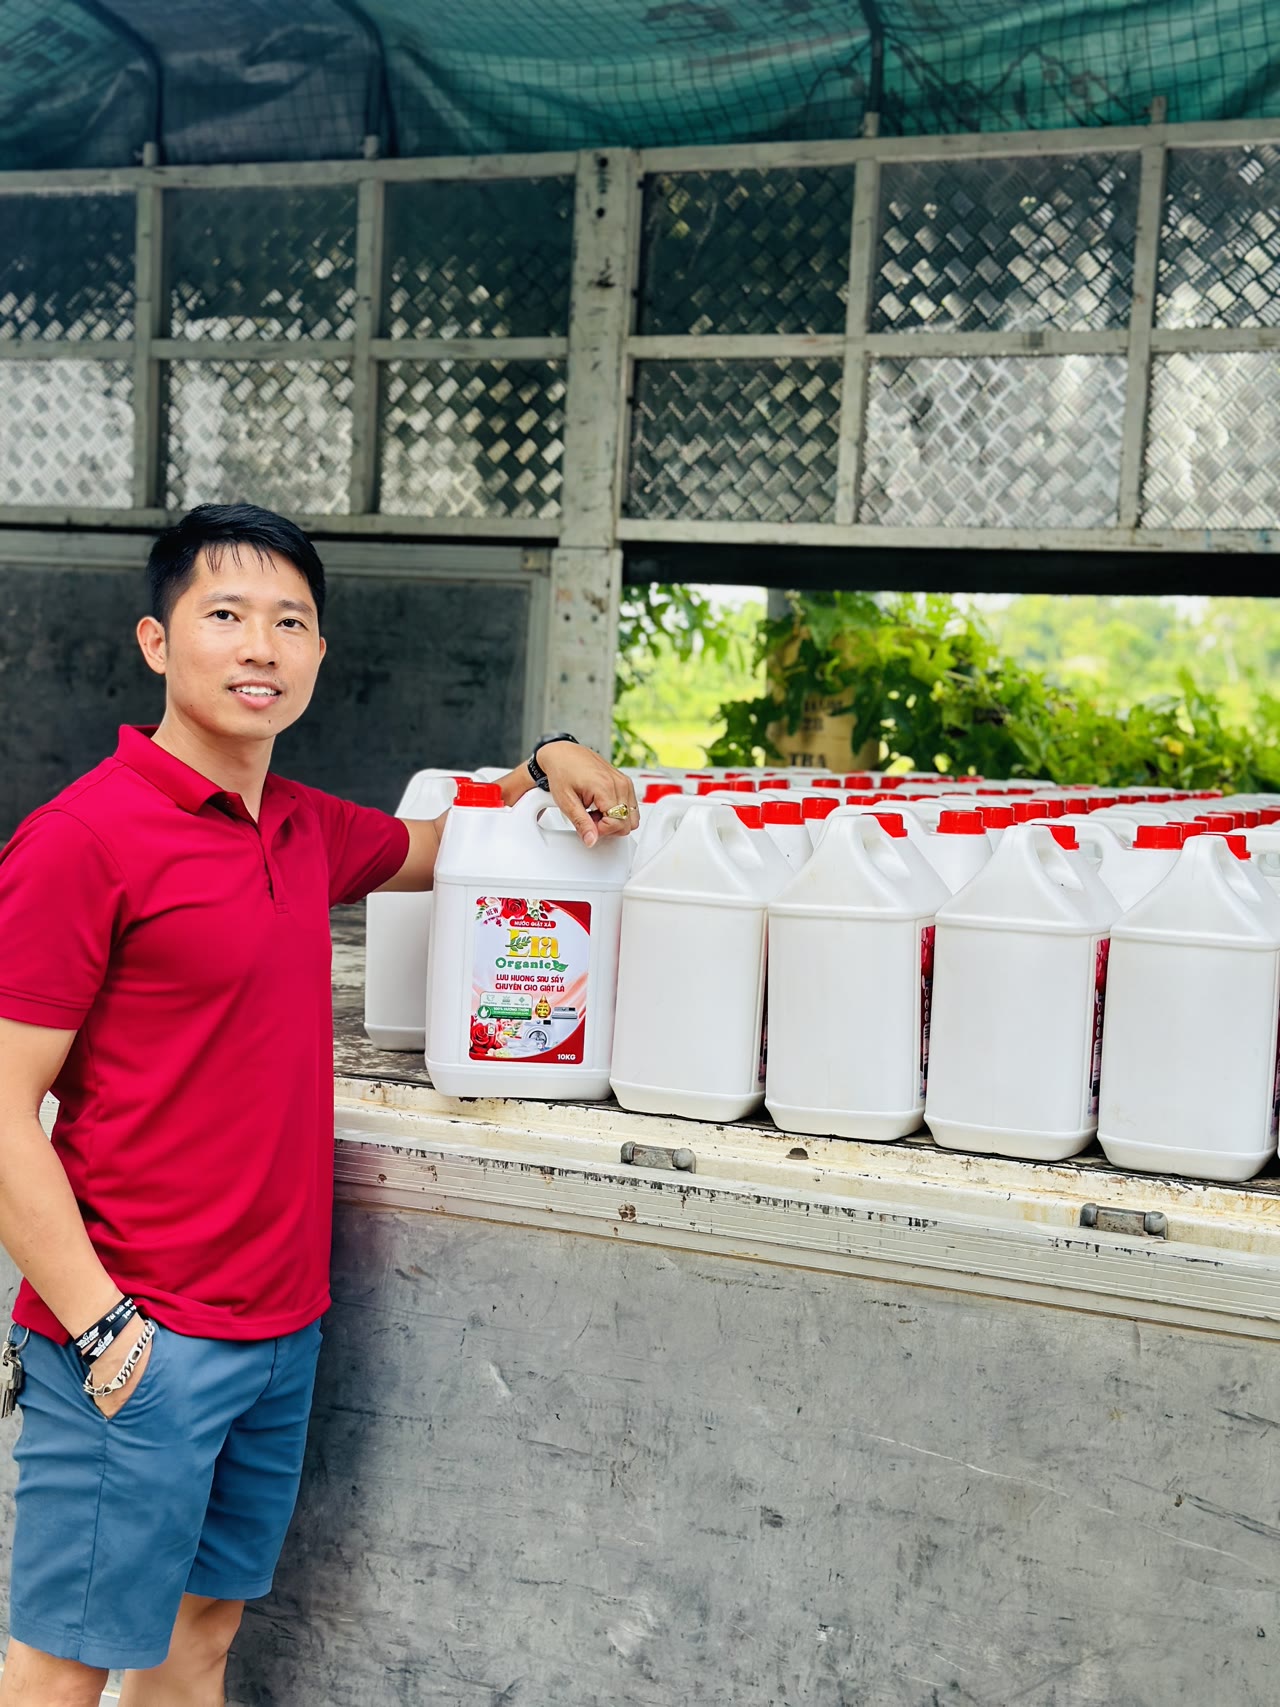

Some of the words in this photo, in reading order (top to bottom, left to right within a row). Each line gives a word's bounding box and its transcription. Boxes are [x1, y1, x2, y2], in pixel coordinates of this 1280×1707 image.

[486, 907, 499, 916] NEW
[495, 957, 552, 970] Organic
[537, 975, 549, 983] SAU
[557, 1053, 576, 1061] 10KG
